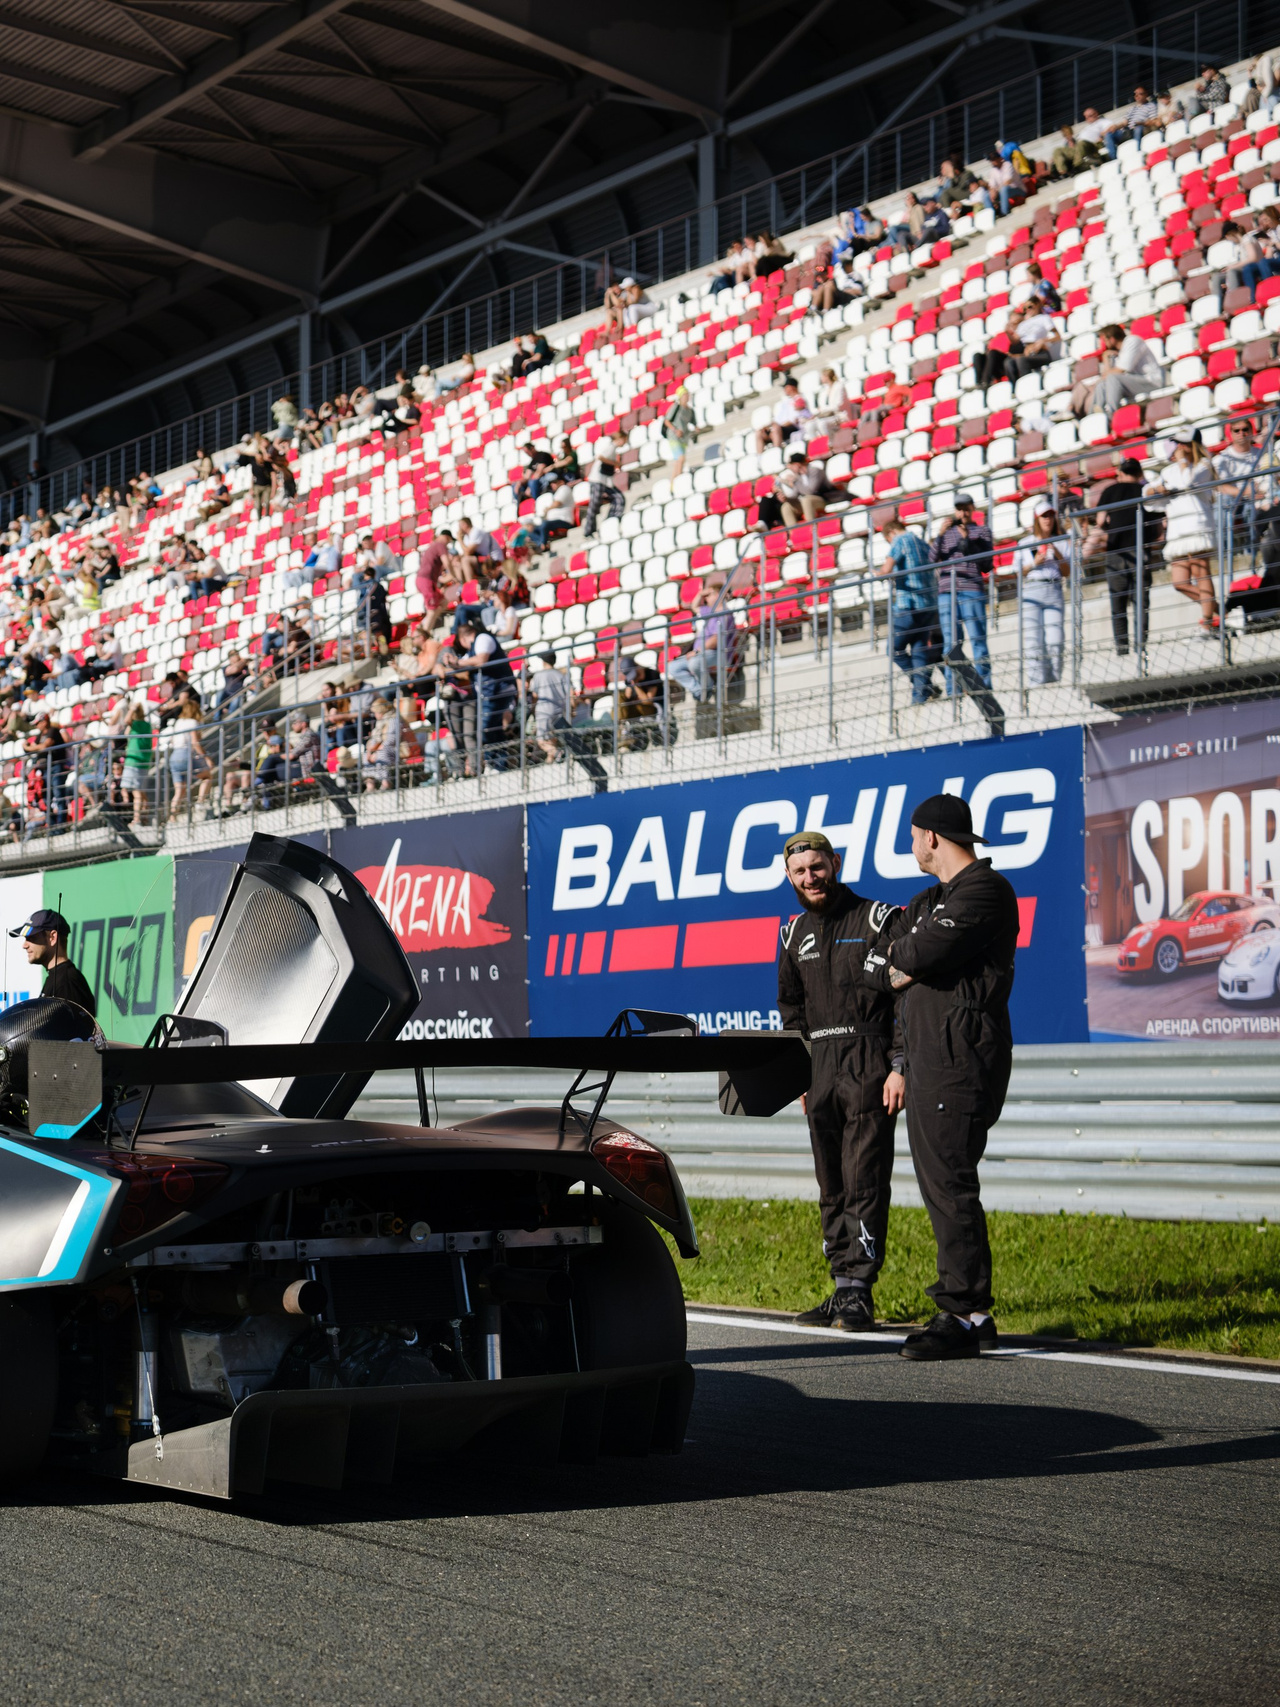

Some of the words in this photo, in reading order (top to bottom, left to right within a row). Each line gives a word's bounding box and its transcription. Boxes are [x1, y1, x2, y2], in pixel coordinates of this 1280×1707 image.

[552, 767, 1056, 912] BALCHUG
[373, 838, 471, 937] ARENA
[686, 1009, 783, 1035] ALCHUG-R
[810, 1026, 847, 1039] VERESCHAGIN
[1146, 1018, 1199, 1037] АРЕНДА
[1202, 1016, 1280, 1035] СПОРТИВН
